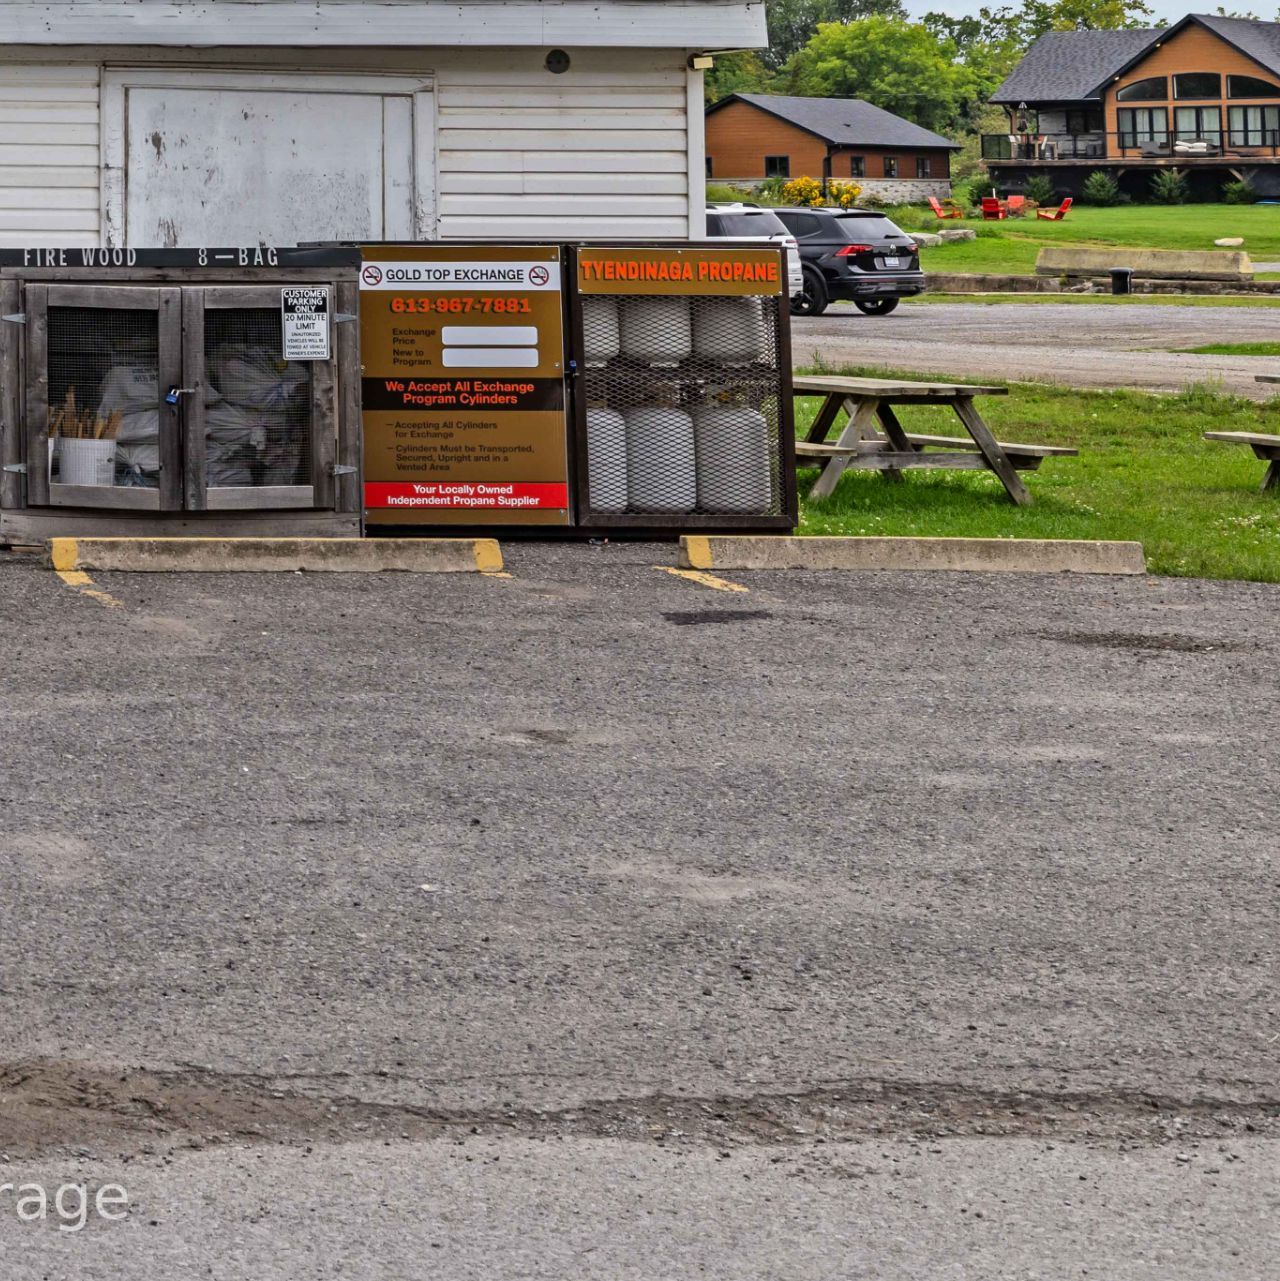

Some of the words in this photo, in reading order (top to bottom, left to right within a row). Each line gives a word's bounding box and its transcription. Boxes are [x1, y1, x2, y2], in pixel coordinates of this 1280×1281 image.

[24, 247, 68, 266] FIRE
[82, 247, 136, 266] WOOD
[386, 269, 421, 280] GOLD
[425, 269, 451, 280] TOP
[454, 269, 524, 280] EXCHANGE
[580, 261, 693, 282] TYENDINAGA
[698, 262, 778, 282] PROPANE
[391, 297, 531, 313] 613-967-7881
[392, 328, 436, 338] Exchange
[392, 337, 416, 345] Price
[393, 358, 432, 367] Program
[385, 381, 405, 392] We
[408, 381, 451, 393] Accept
[454, 381, 470, 392] All
[474, 381, 535, 394] Exchange
[403, 394, 456, 406] Program
[459, 393, 518, 406] Cylinders
[395, 422, 439, 431] Accepting
[442, 421, 454, 429] All
[456, 421, 498, 431] Cylinders
[410, 431, 454, 440] Exchange
[395, 445, 437, 454] Cylinders
[479, 445, 535, 454] Transported,
[396, 454, 436, 463] Secured,
[438, 454, 471, 464] Upright
[413, 485, 436, 494] Your
[439, 485, 475, 496] Locally
[477, 485, 513, 494] Owned
[387, 496, 450, 507] Independent
[453, 496, 495, 507] Propane
[498, 496, 540, 507] Supplier
